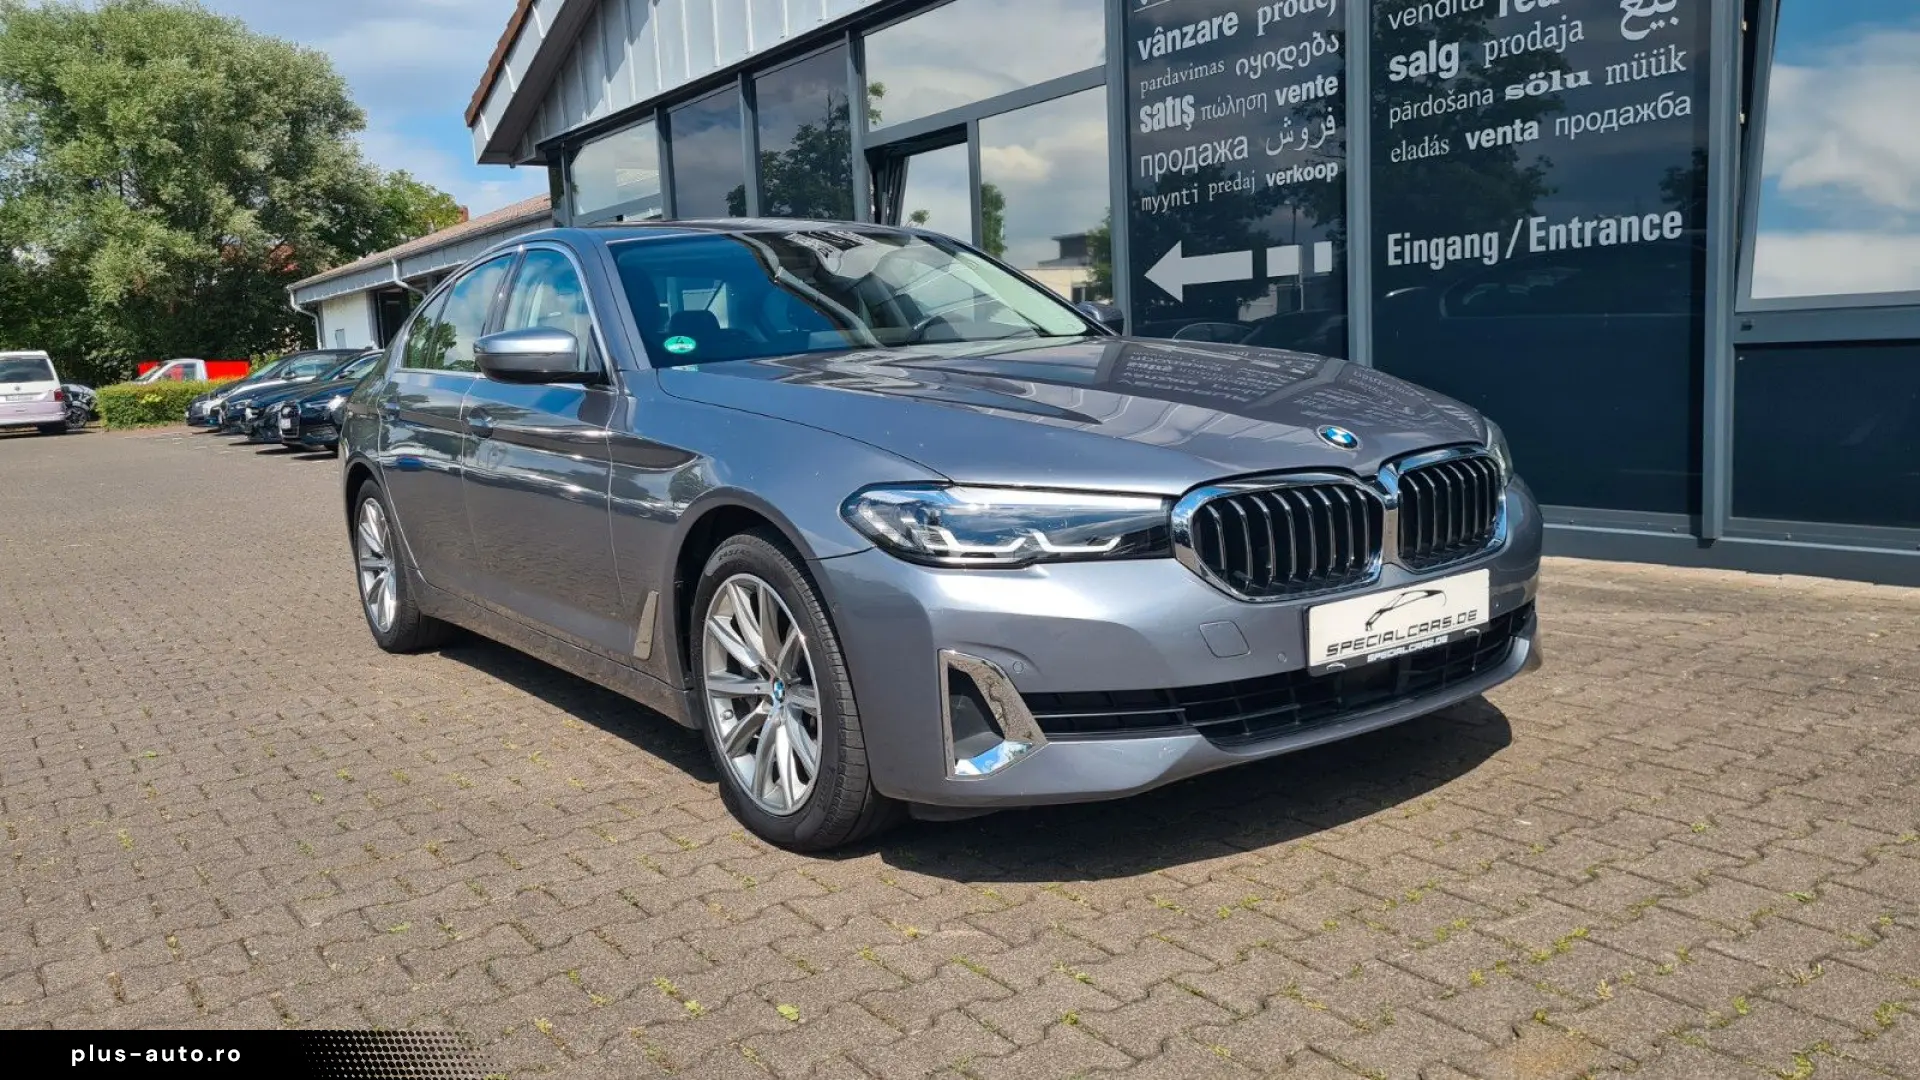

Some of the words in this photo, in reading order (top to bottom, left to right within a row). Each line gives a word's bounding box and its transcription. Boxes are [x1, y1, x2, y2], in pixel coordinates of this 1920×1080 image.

[1138, 12, 1239, 60] vânzare
[1235, 31, 1339, 79] იყიდება
[1388, 39, 1460, 82] salg
[1483, 15, 1584, 68] prodaja
[1140, 60, 1225, 98] pardavimas
[1275, 74, 1339, 106] vente
[1389, 87, 1493, 128] pārdošana
[1505, 70, 1592, 100] sölu
[1605, 45, 1687, 86] müük
[1139, 94, 1195, 133] satış
[1201, 92, 1267, 121] πώληση
[1555, 92, 1692, 140] продажба
[1265, 106, 1336, 156] فروش
[1391, 135, 1449, 162] eladás
[1465, 118, 1539, 150] venta
[1140, 135, 1249, 182] продажа
[1141, 183, 1198, 214] myynti
[1208, 170, 1256, 201] predaj
[1266, 161, 1339, 187] verkoop
[1326, 609, 1478, 657] SPECIALCARS.DE
